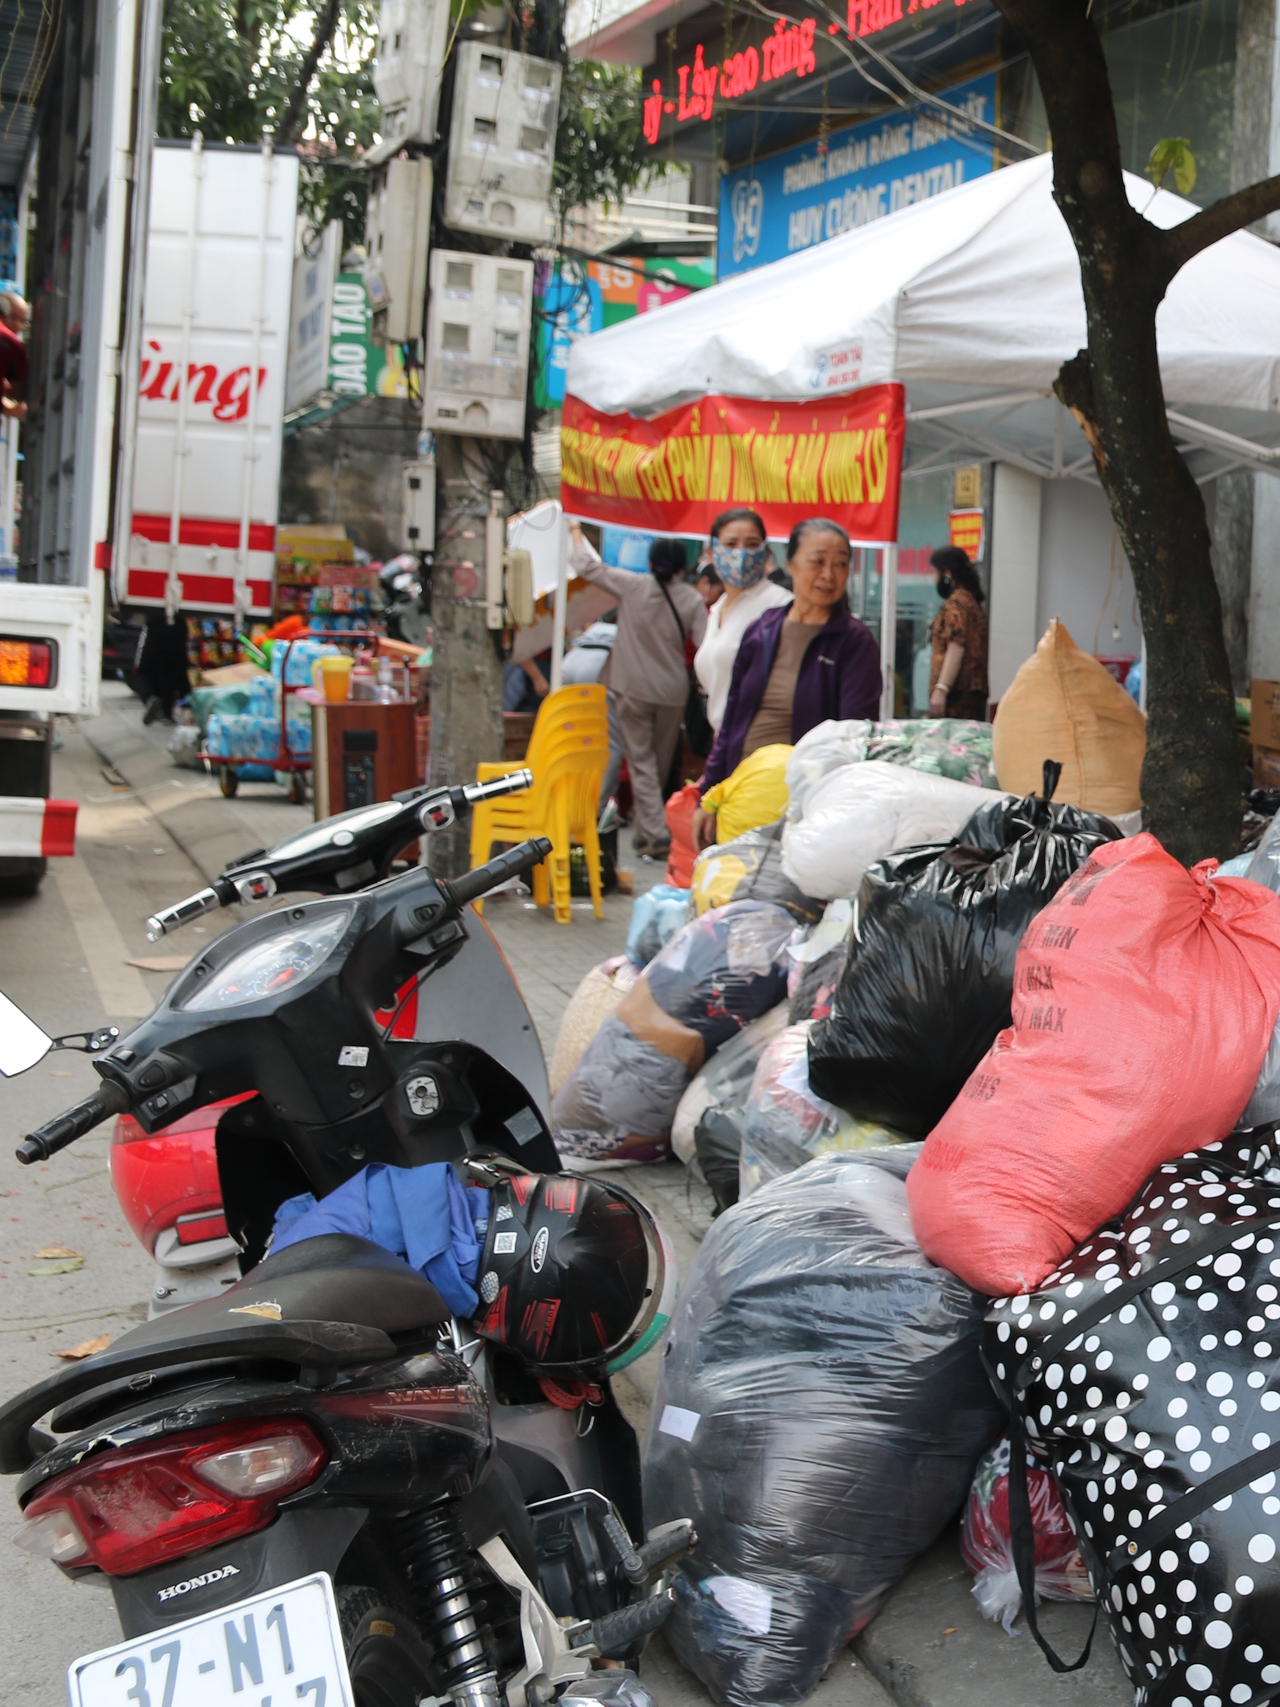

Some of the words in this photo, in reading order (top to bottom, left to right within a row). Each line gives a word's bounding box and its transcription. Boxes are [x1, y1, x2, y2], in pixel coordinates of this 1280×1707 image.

[676, 43, 719, 121] Lấy
[720, 46, 759, 98] cao
[788, 204, 825, 250] HUY
[1029, 1005, 1067, 1032] MAX
[387, 1388, 456, 1403] WAVE
[156, 1564, 241, 1602] HONDA
[115, 1603, 295, 1707] 37-N1
